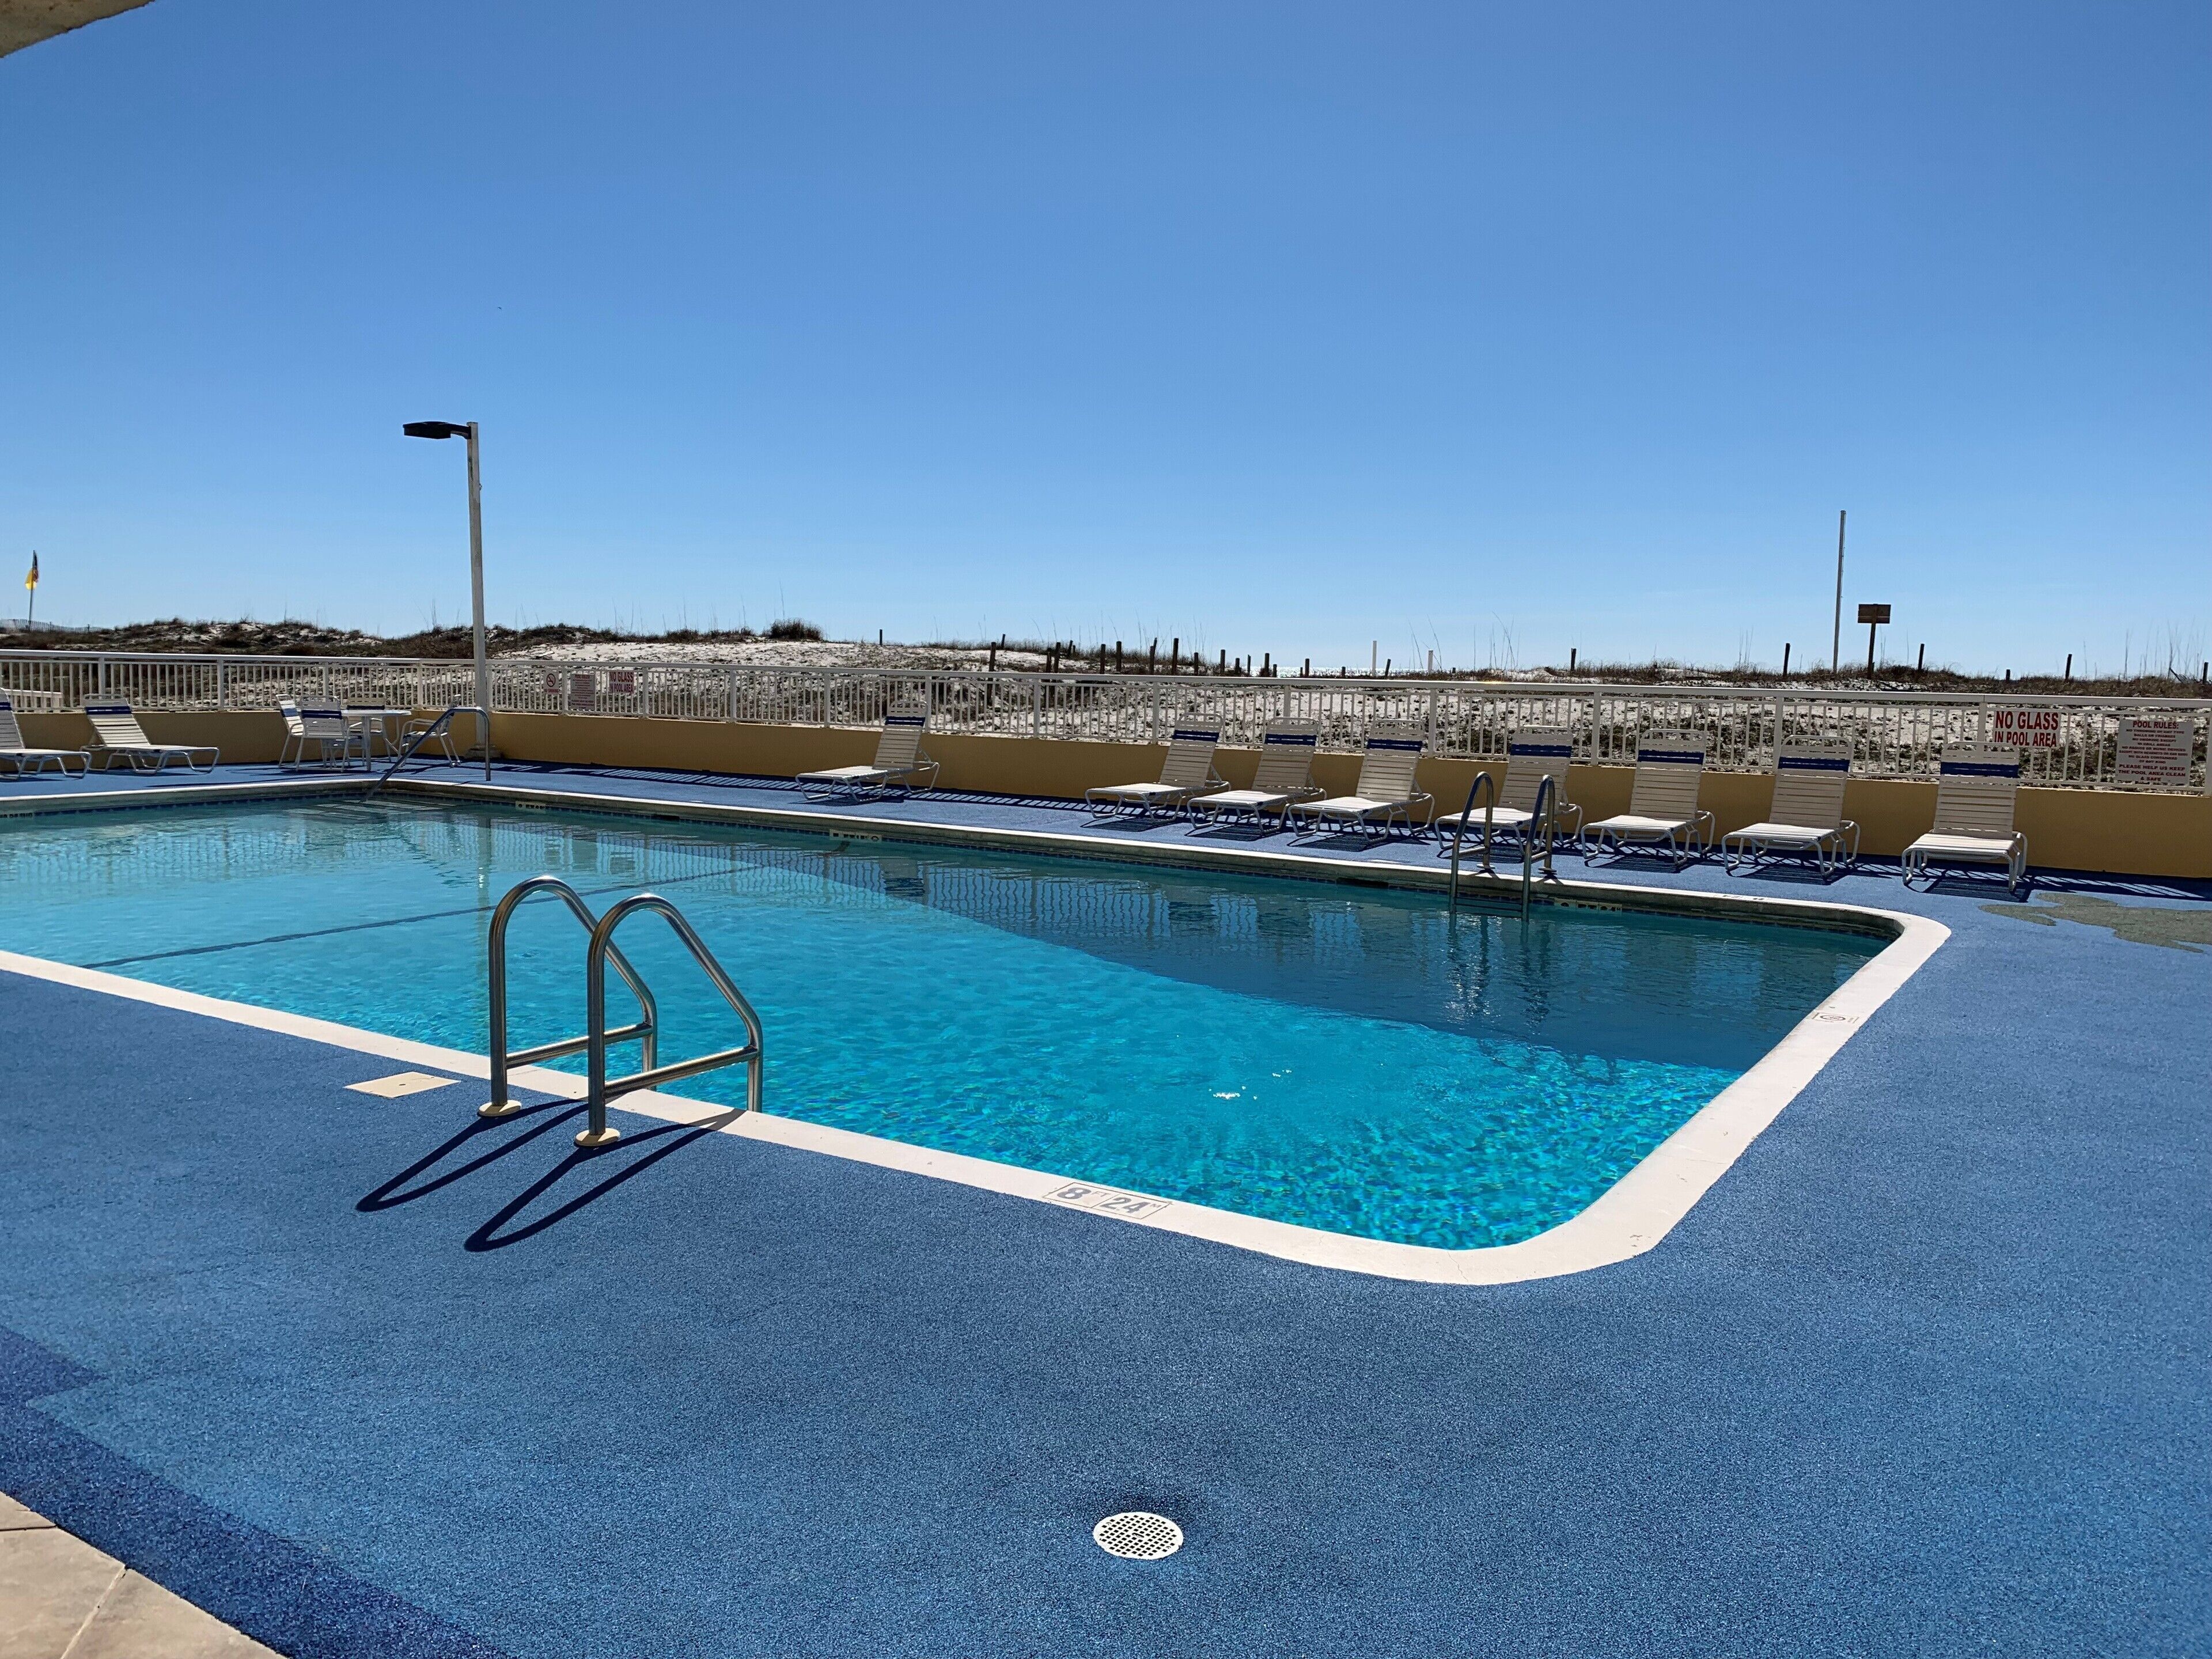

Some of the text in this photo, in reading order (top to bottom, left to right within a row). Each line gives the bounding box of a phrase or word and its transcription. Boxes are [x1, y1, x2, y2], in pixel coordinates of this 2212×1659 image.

[609, 671, 633, 682] NO GLASS
[624, 684, 633, 692] AREA
[1995, 711, 2059, 730] NO GLASS
[2154, 721, 2179, 729] RULES:
[1994, 731, 2057, 747] IN POOL AREA
[1057, 1187, 1092, 1199] 8
